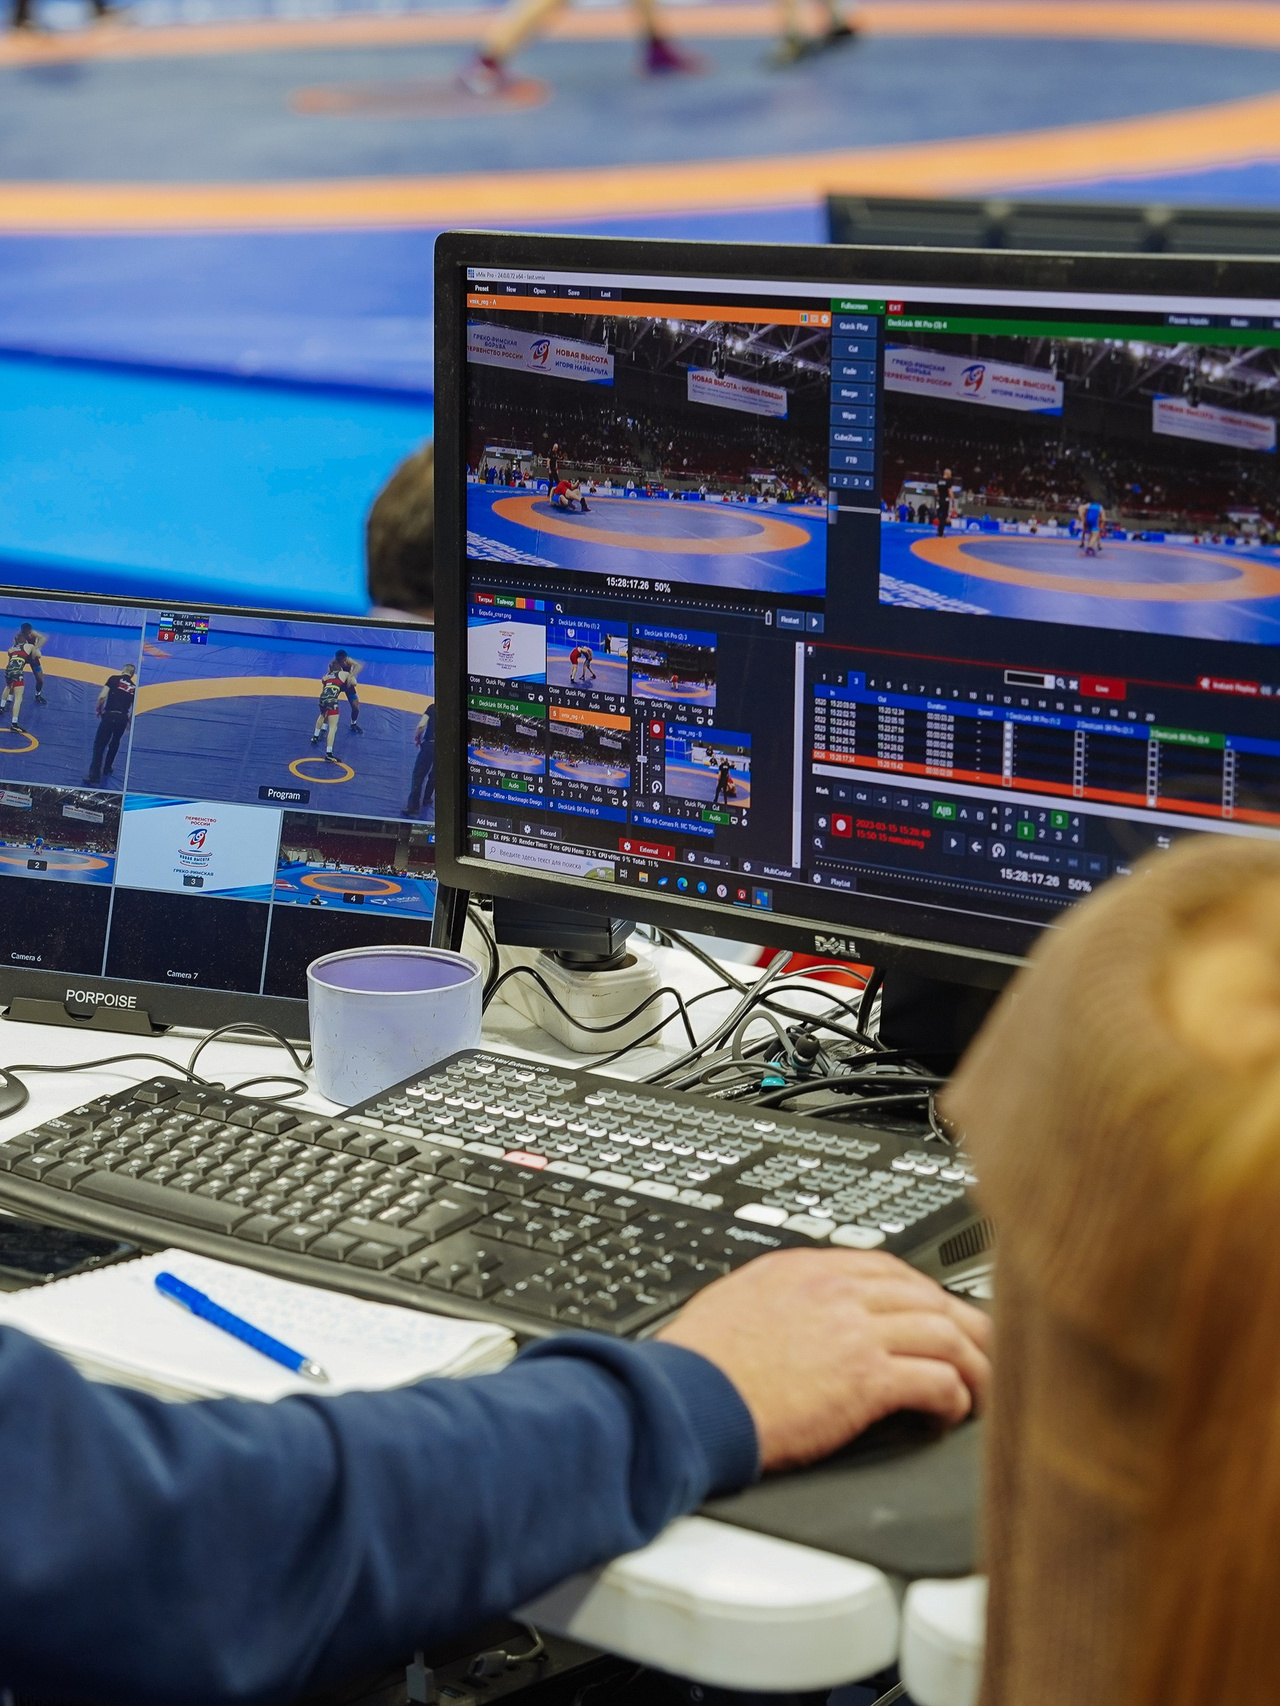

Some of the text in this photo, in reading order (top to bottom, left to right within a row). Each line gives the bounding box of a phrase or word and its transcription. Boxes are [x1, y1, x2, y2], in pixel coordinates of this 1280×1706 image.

[840, 303, 868, 311] Fullscreen
[889, 304, 901, 312] EXT
[839, 322, 869, 332] Quick Play
[473, 333, 517, 346] ГРЕКО-РИМСКАЯ
[484, 341, 506, 349] БОРЬБА
[848, 345, 859, 353] Cut
[502, 352, 523, 360] РОССИИ
[555, 349, 608, 365] НОВАЯ ВЫСОТА
[555, 361, 608, 376] ИГОРЯ НАЙВАЛЬТА
[843, 367, 857, 375] Fade
[692, 374, 712, 384] НОВАЯ
[714, 378, 737, 390] ВЫСОТА
[841, 390, 858, 398] Merge
[842, 412, 857, 420] Wipe
[606, 577, 671, 594] 15:28:17.26 50%
[781, 615, 800, 624] Restart
[174, 634, 190, 642] 0:25
[486, 678, 497, 686] Quick
[497, 680, 506, 688] Play
[565, 689, 576, 697] Quick
[577, 691, 586, 699] Play
[604, 694, 615, 703] Loop
[589, 702, 600, 710] Audio
[634, 699, 645, 707] Close
[651, 701, 662, 709] Quick
[663, 703, 672, 711] Play
[692, 707, 702, 715] Loop
[675, 714, 687, 722] Audio
[470, 766, 481, 774] Close
[486, 769, 497, 777] Quick
[497, 770, 506, 778] Play
[523, 774, 534, 782] Loop
[508, 782, 519, 790] Audio
[551, 779, 617, 796] Close Quick Play Cut Loop
[268, 788, 301, 801] Program
[856, 793, 867, 801] Out
[684, 800, 697, 808] Quick
[697, 802, 706, 810] Play
[709, 814, 721, 822] Audio
[959, 809, 967, 818] A
[976, 812, 984, 821] B
[1005, 808, 1079, 827] P 2 3 4
[185, 815, 217, 823] ПЕРВЕНСТВО
[486, 820, 498, 828] Input
[540, 829, 557, 837] Record
[1004, 824, 1012, 832] P
[1039, 829, 1046, 838] 2
[1055, 832, 1063, 840] 3
[1072, 834, 1079, 843] 4
[639, 846, 659, 855] External
[499, 849, 520, 859] Введите
[521, 854, 536, 862] здесь
[562, 861, 582, 870] поиска
[1016, 850, 1050, 862] Play Events
[703, 857, 720, 866] Stream
[173, 868, 214, 876] ГРЕКО-РИМСКАЯ
[763, 866, 792, 878] MultiCorder
[831, 878, 851, 888] PlayList
[1000, 867, 1093, 893] 15:28:17.26 50%
[815, 935, 856, 955] DELL
[11, 952, 35, 962] Camera
[166, 969, 199, 980] Camera 7
[65, 989, 137, 1009] PORPOISE
[473, 1054, 495, 1062] ATEM
